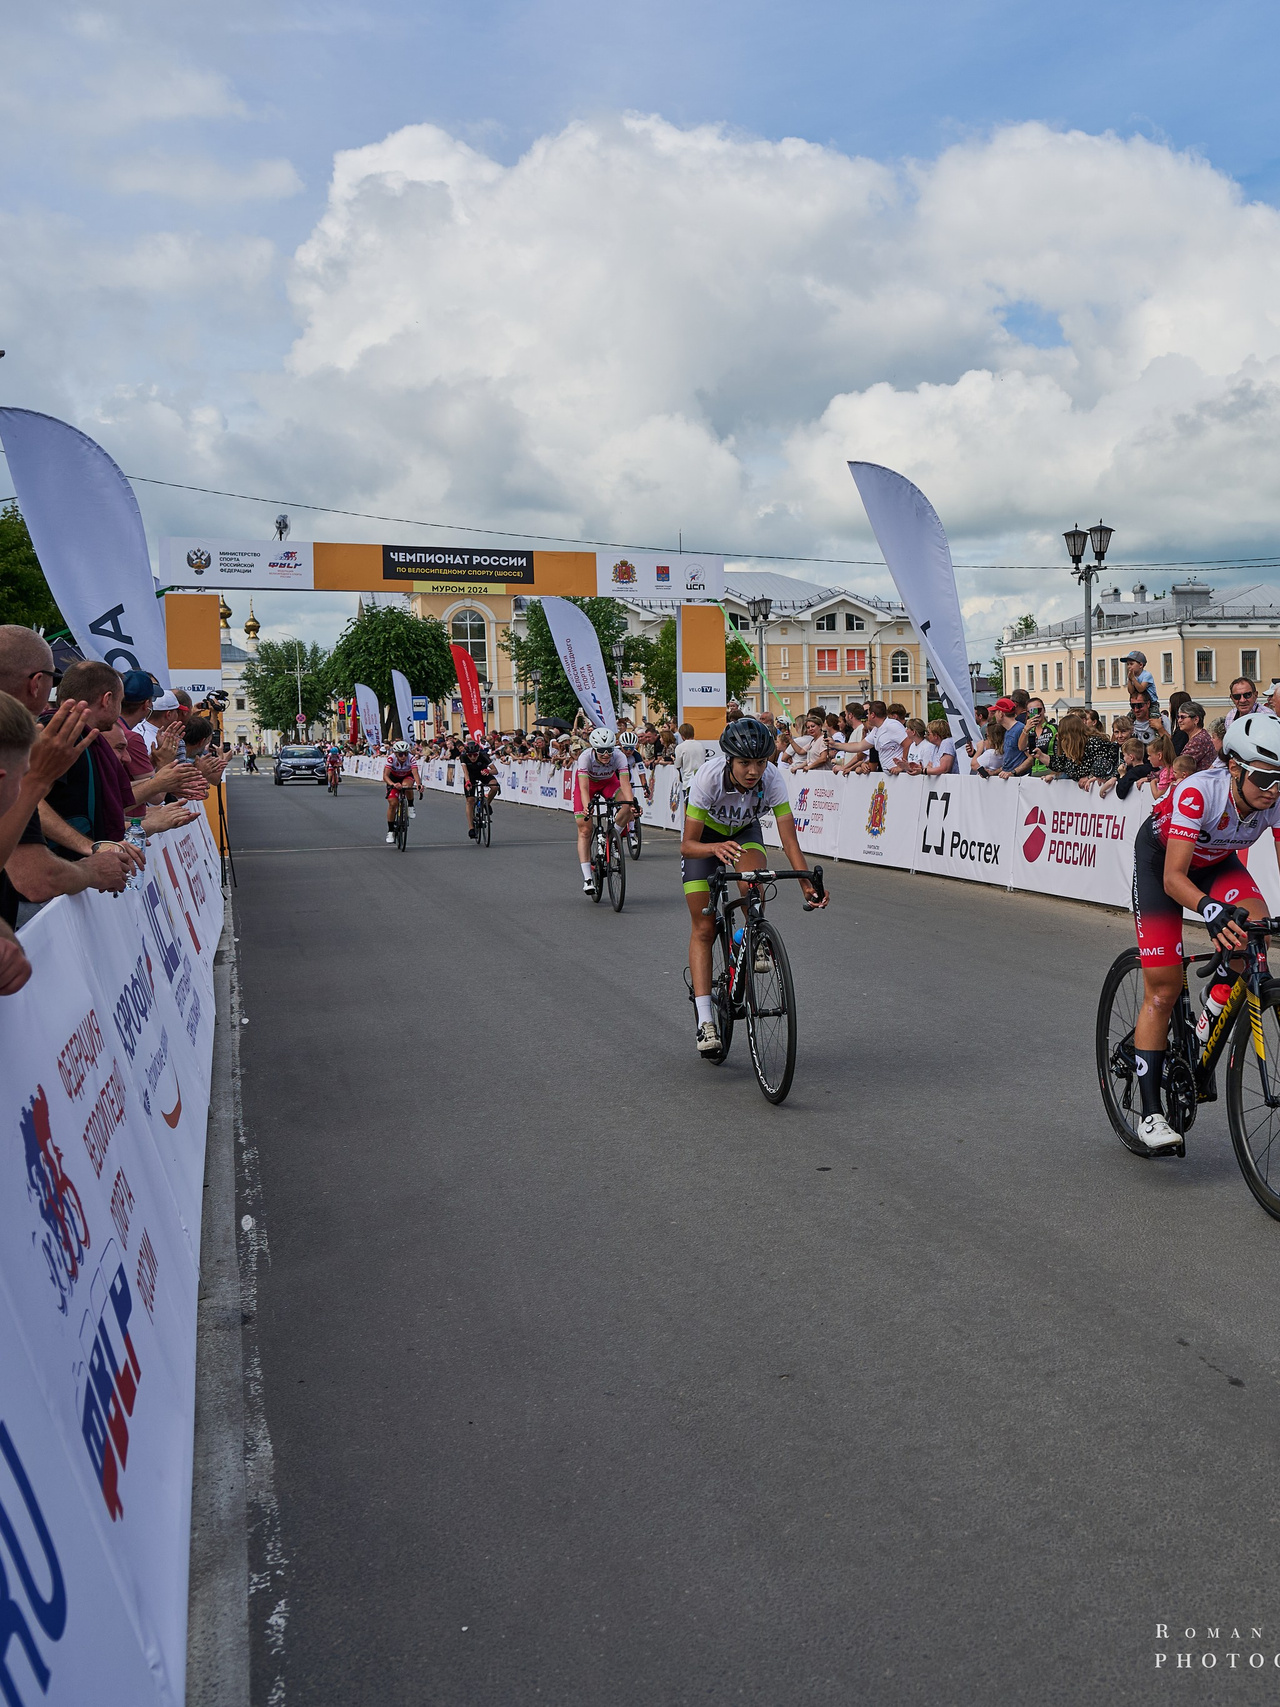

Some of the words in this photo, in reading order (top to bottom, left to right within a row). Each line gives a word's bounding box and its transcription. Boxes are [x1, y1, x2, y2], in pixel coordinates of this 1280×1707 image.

[390, 552, 470, 566] ЧЕМПИОНАТ
[472, 555, 527, 566] РОССИИ
[408, 568, 467, 576] ВЕЛОСИПЕДНОМУ
[431, 585, 465, 593] МУРОМ
[467, 586, 489, 594] 2024
[580, 666, 590, 690] СПОРТА
[587, 663, 596, 689] РОССИИ
[1051, 810, 1127, 841] ВЕРТОЛЕТЫ
[949, 831, 1001, 865] Ростех
[1047, 839, 1097, 868] РОССИИ
[1202, 998, 1233, 1068] ARGON
[57, 1008, 106, 1104] ФЕДЕРАЦИЯ
[110, 1166, 136, 1251] СПОРТА
[136, 1227, 158, 1320] РОССИИ
